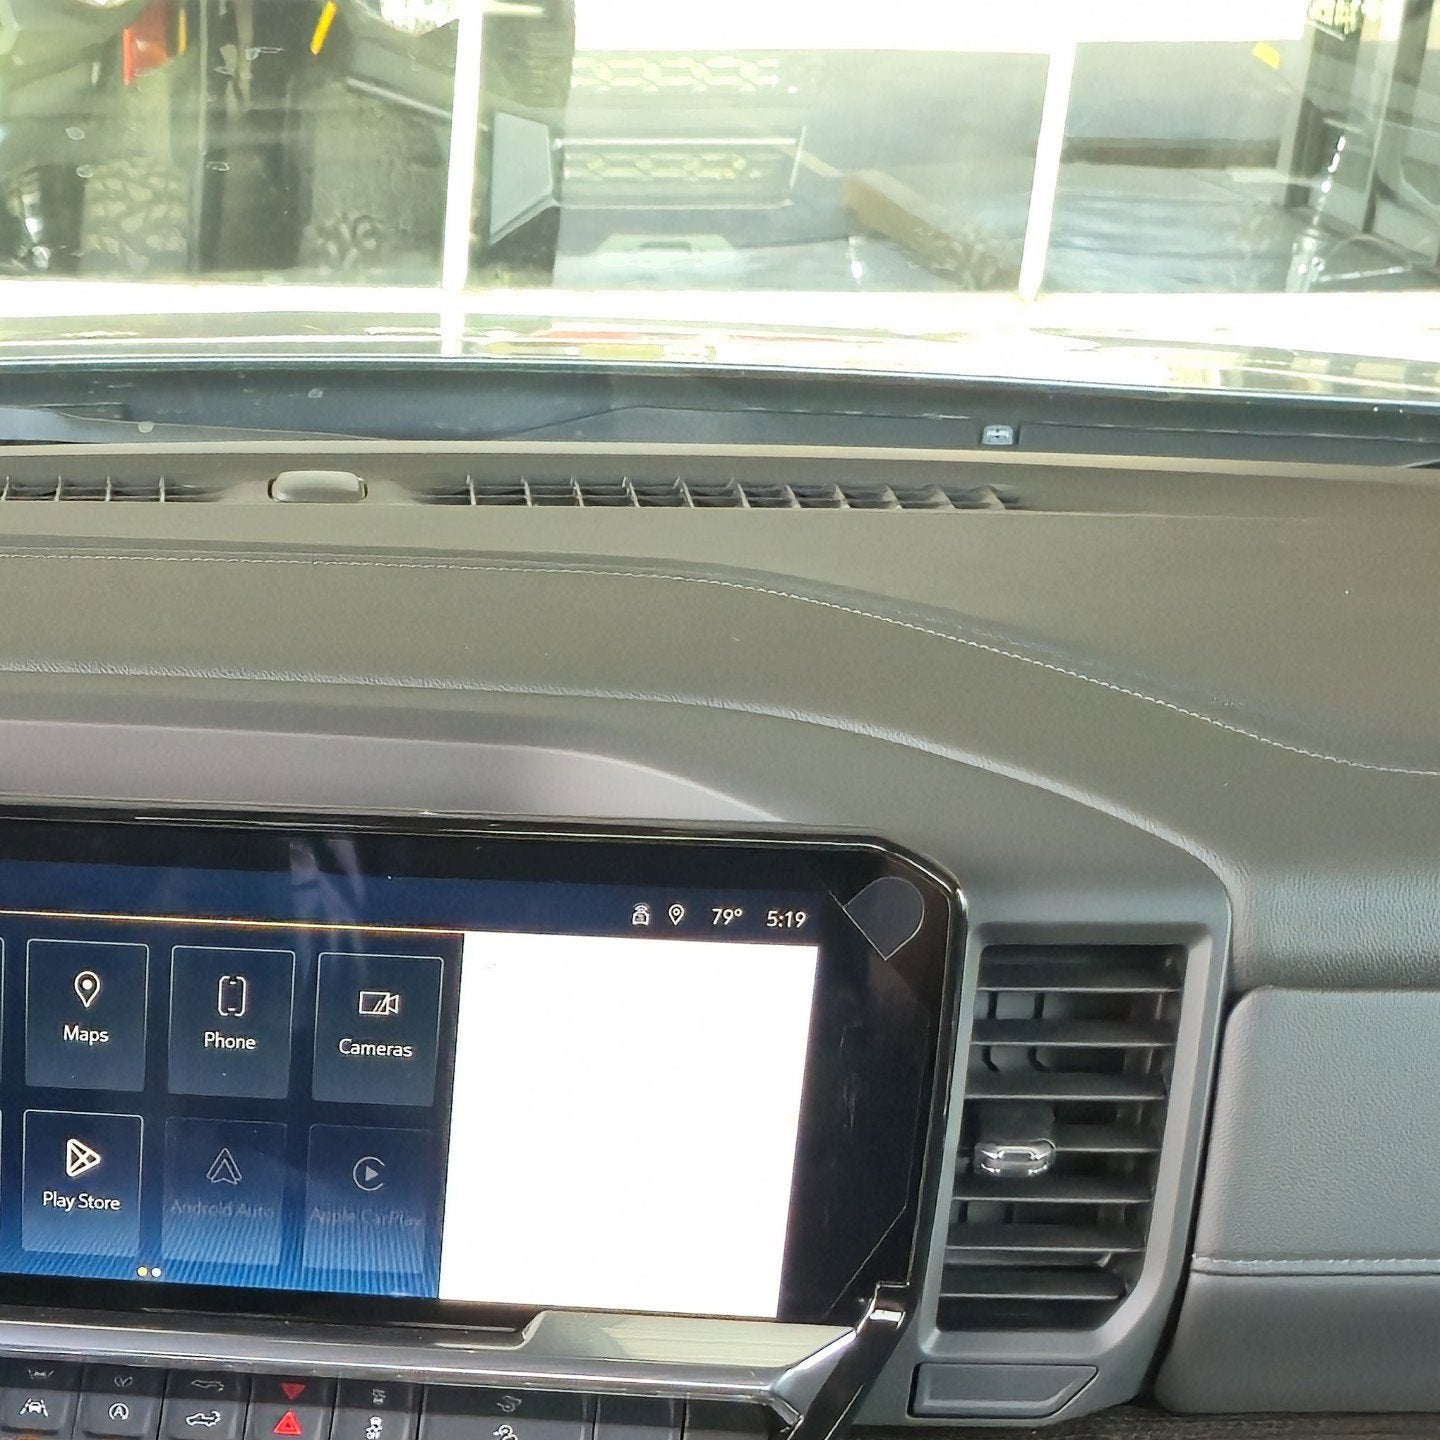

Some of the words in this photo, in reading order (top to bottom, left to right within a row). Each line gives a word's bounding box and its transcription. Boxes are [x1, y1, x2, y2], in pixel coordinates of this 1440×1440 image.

[712, 908, 743, 926] 79°
[766, 910, 807, 928] 5:19
[63, 1024, 109, 1045] Maps
[204, 1031, 257, 1050] Phone
[339, 1038, 413, 1058] Cameras
[43, 1191, 75, 1212] Play
[77, 1194, 120, 1210] Store
[170, 1201, 231, 1217] Android
[236, 1203, 274, 1218] Auto
[310, 1208, 356, 1225] Apple
